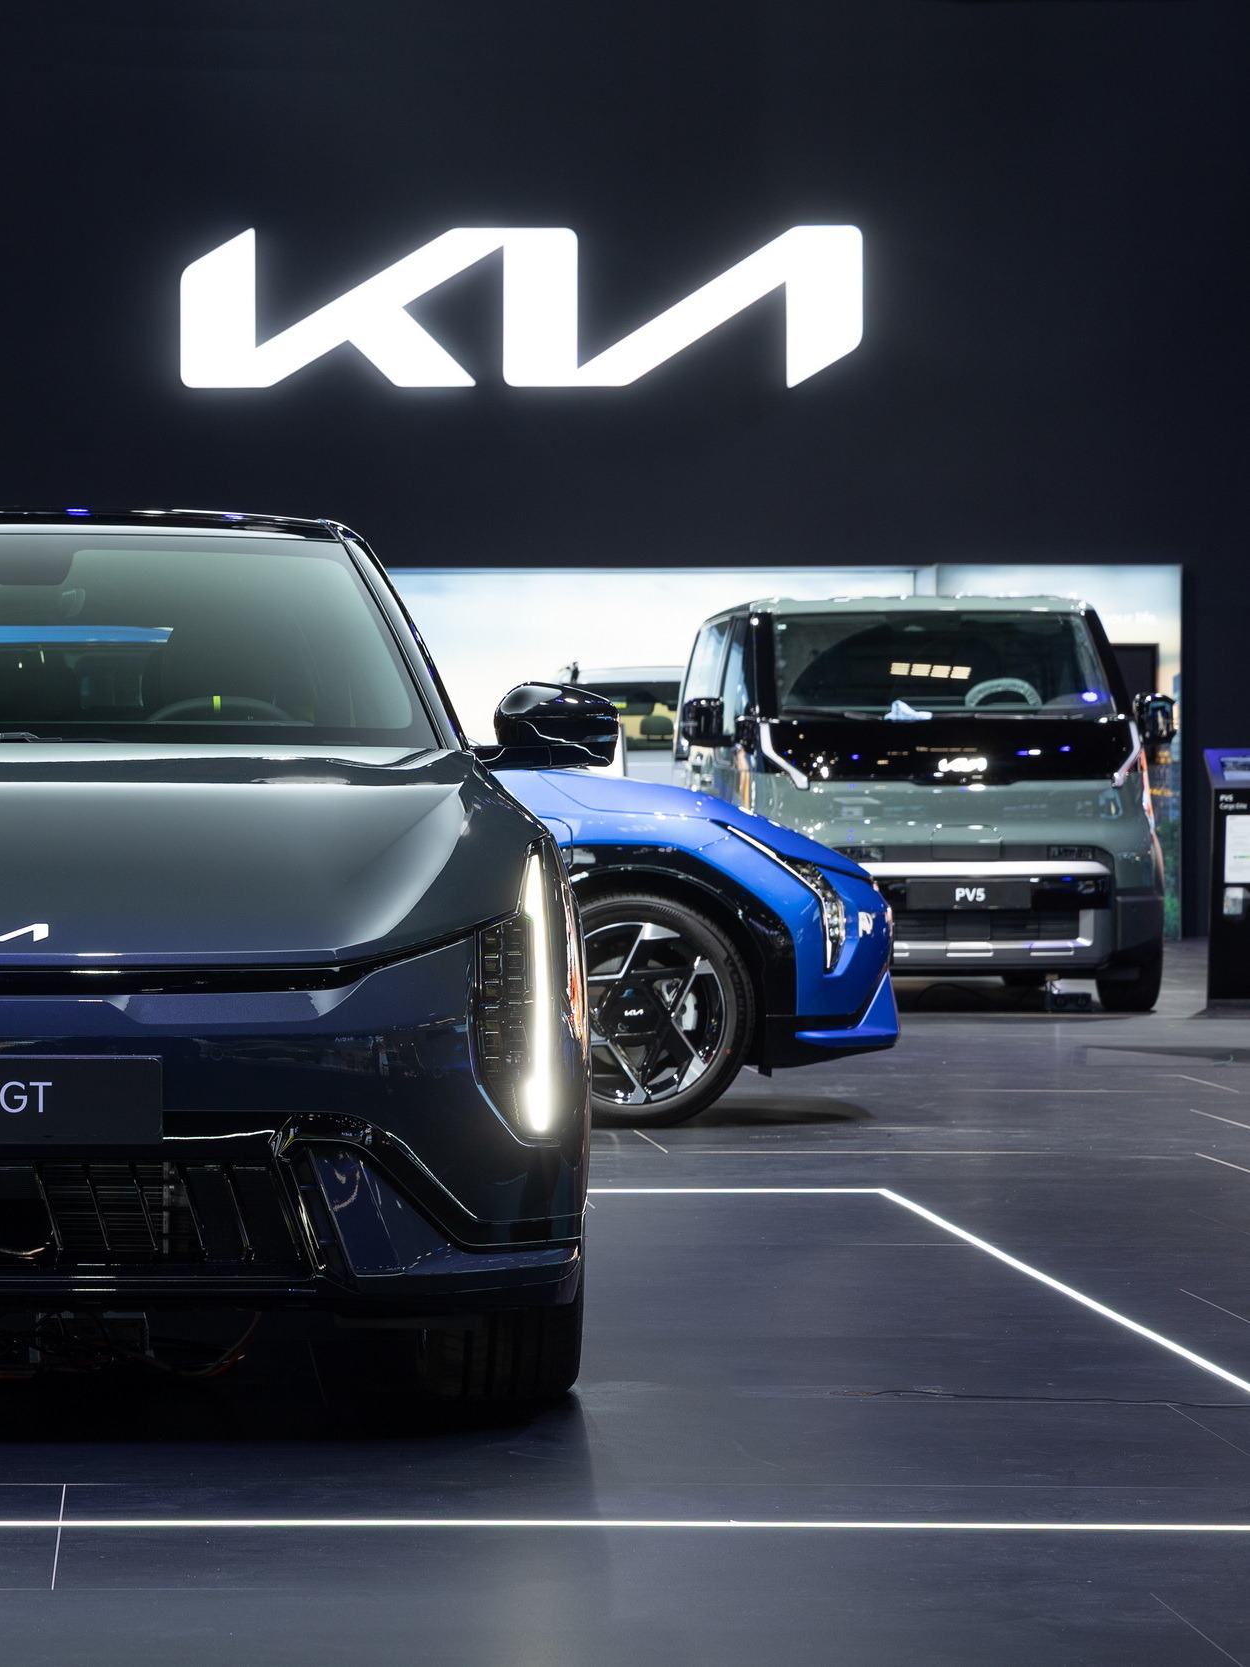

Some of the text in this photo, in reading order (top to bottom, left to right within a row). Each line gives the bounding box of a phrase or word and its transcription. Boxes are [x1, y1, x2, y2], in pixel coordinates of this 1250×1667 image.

[180, 224, 864, 389] KIA
[955, 887, 986, 902] PV5
[624, 1008, 644, 1017] KIA
[0, 1080, 53, 1114] GT
